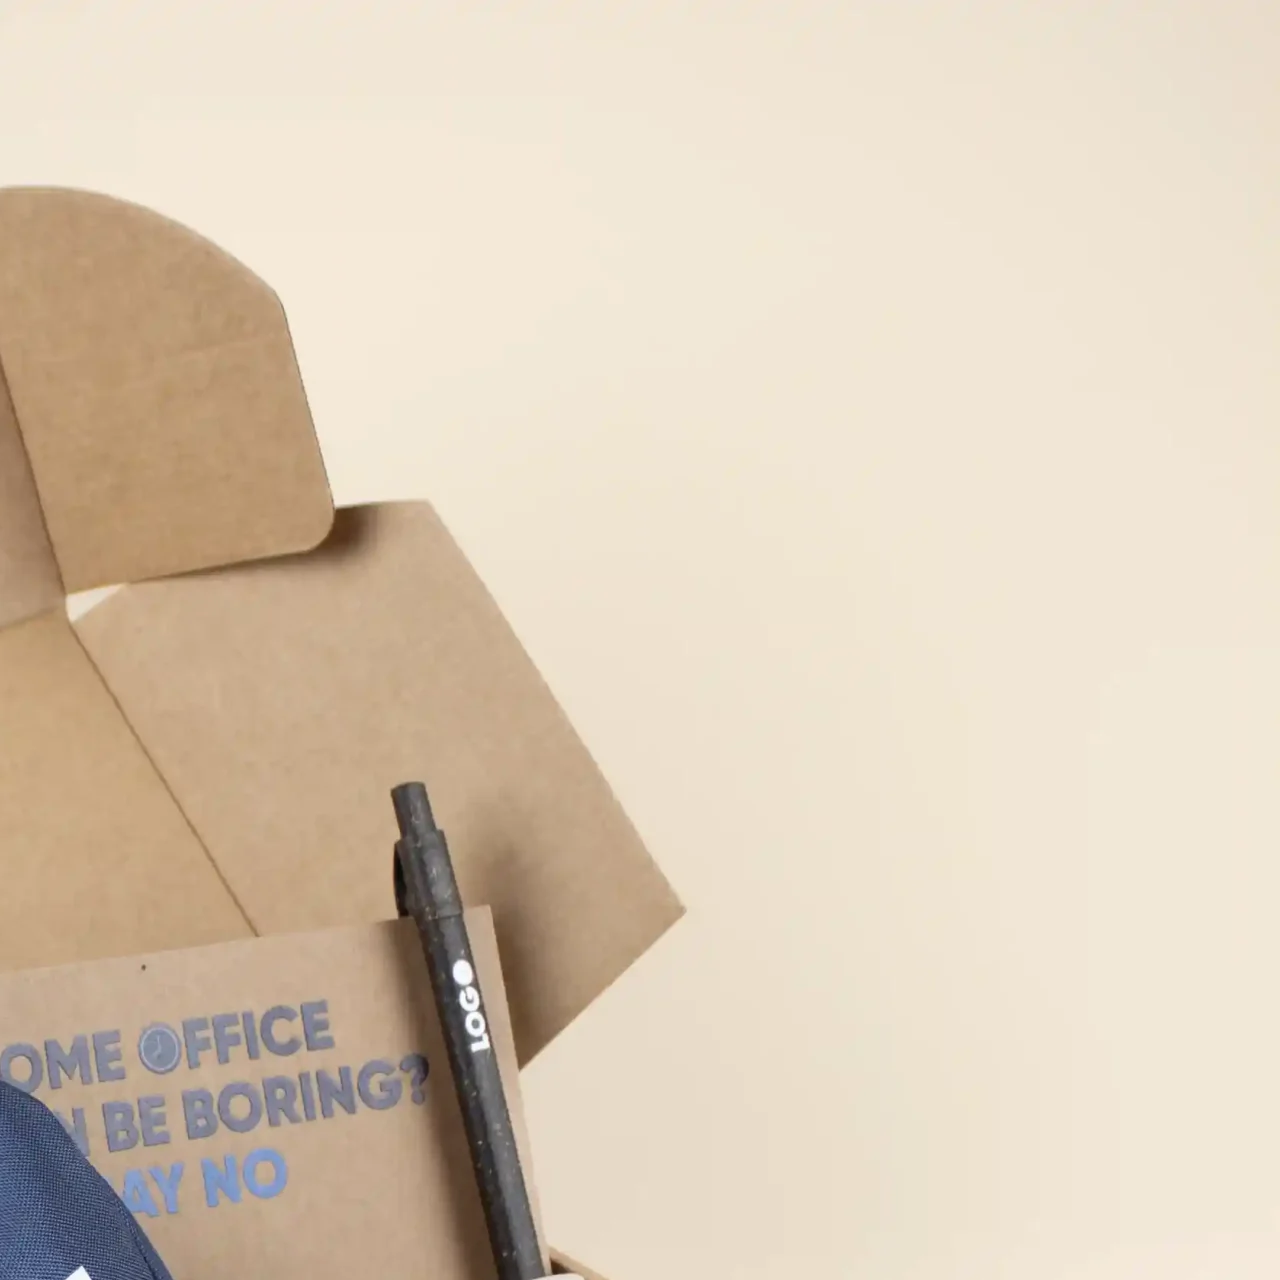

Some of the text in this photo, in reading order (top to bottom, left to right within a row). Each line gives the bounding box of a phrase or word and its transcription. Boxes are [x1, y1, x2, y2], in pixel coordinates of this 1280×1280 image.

[138, 999, 336, 1075] OFFICE
[103, 1093, 171, 1153] BE
[183, 1053, 431, 1139] BORING?
[118, 1147, 288, 1218] AY NO
